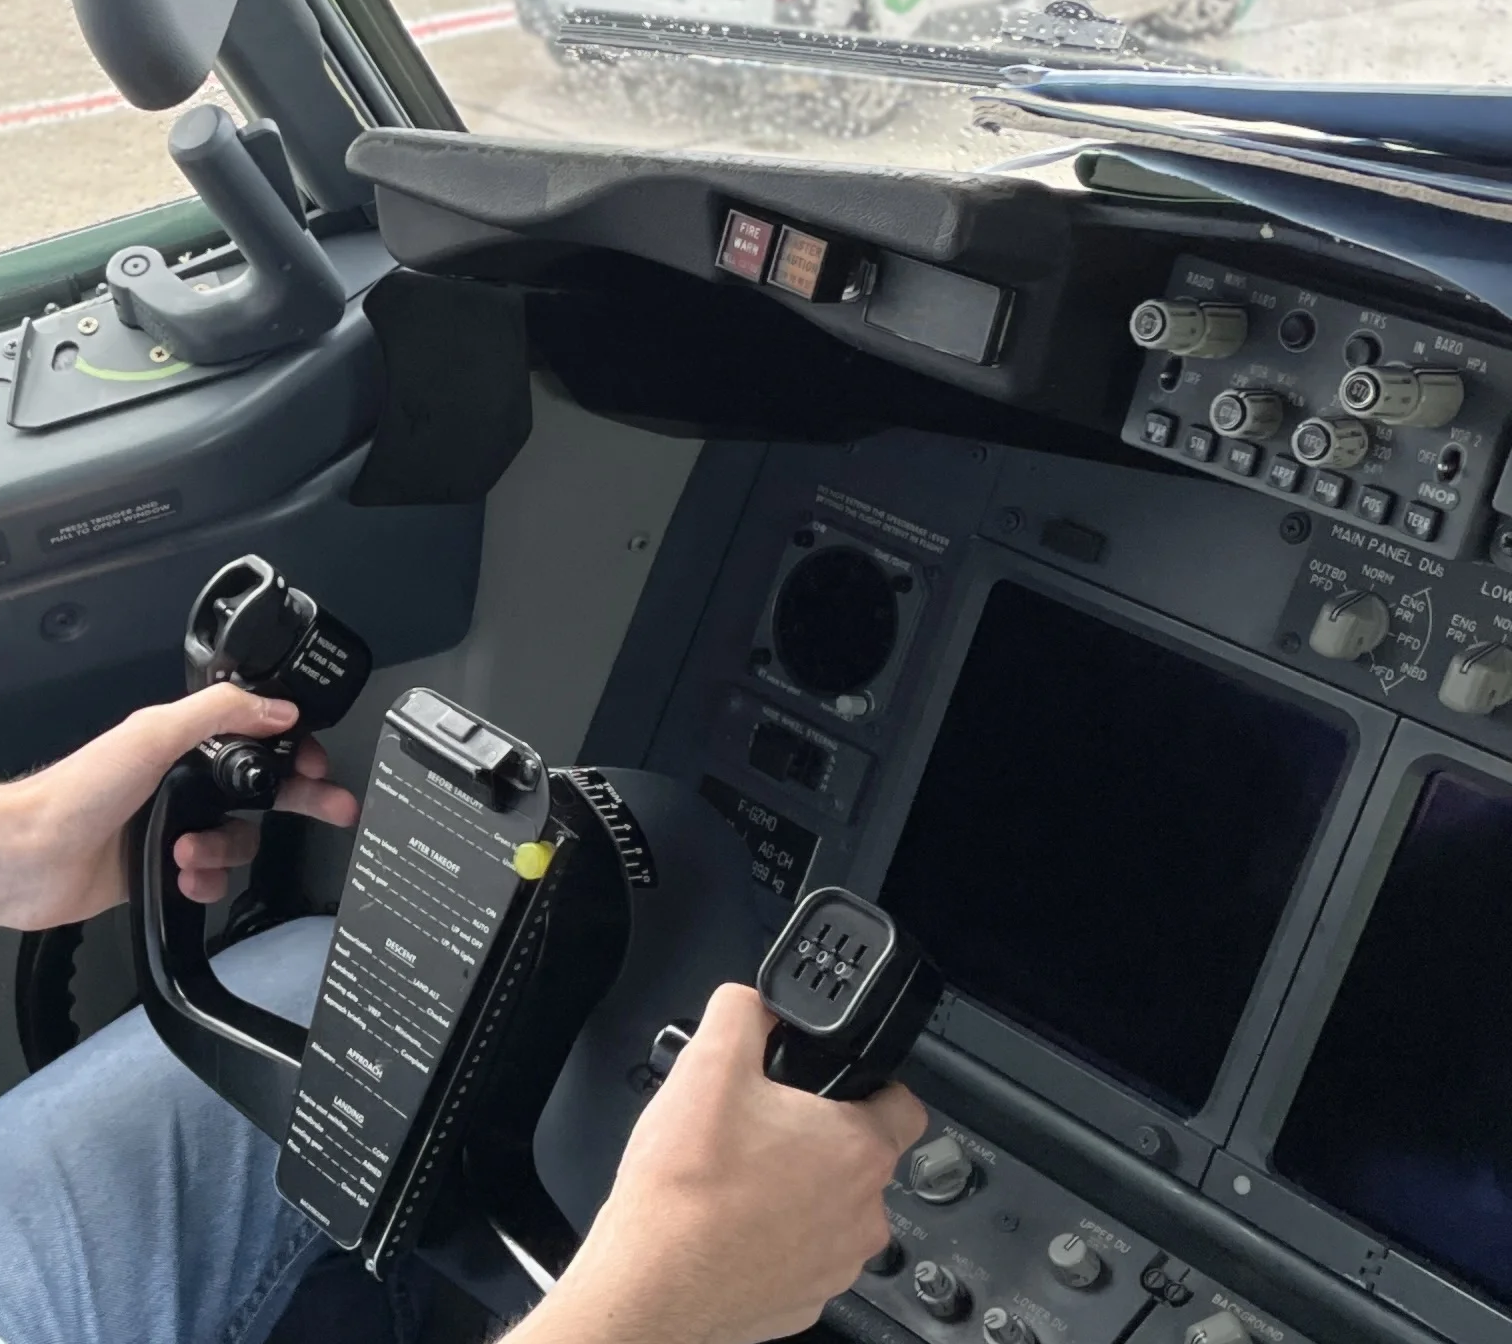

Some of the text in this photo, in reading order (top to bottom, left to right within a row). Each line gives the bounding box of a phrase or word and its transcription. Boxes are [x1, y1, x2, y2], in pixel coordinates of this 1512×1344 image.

[739, 222, 762, 240] FIRE
[733, 237, 759, 257] WARN
[1298, 291, 1318, 307] FPV
[1360, 312, 1388, 329] MTRS
[1413, 341, 1426, 355] IN
[1434, 335, 1464, 355] BARO
[1466, 357, 1487, 373] HPA
[1473, 435, 1481, 447] 2
[1374, 446, 1392, 460] 320
[1418, 449, 1438, 464] OFF
[1271, 465, 1295, 481] ARPT
[1316, 479, 1337, 497] DATA
[1418, 481, 1456, 504] INOP
[1362, 495, 1382, 513] POS
[50, 532, 73, 545] PULL
[75, 528, 91, 537] TO
[92, 519, 121, 532] OPEN
[123, 503, 171, 523] WINDOW
[59, 520, 88, 535] PRESS
[90, 508, 135, 527] TRIGGER
[135, 500, 159, 513] AND
[1407, 511, 1432, 531] TERR
[1330, 523, 1445, 578] MAIN PANEL DUs
[1309, 559, 1348, 582] OUTBD
[1361, 564, 1395, 586] NORM
[1310, 574, 1334, 592] PFD
[1399, 594, 1426, 613] ENG
[1395, 608, 1415, 624] PRI
[1451, 614, 1477, 633] ENG
[317, 636, 336, 654] NOSE
[1396, 632, 1421, 651] PFD
[1446, 627, 1467, 644] PRI
[308, 650, 345, 677] STAB TRIM
[1369, 663, 1395, 681] MFD
[1399, 662, 1428, 682] INBD
[299, 663, 330, 686] NOSE UP
[427, 770, 484, 810] BEFORE TAKEOFF
[603, 781, 622, 803] TRIM
[409, 837, 461, 874] AFTER TAKEOFF
[758, 840, 794, 870] AG-CH
[772, 872, 785, 895] kg
[486, 907, 496, 918] ON
[472, 919, 489, 933] AUTO
[451, 924, 460, 934] UP
[471, 937, 484, 949] OFF
[385, 937, 417, 963] DESCENT
[798, 940, 846, 975] 0 0 0
[412, 978, 440, 1000] LAND ALT
[346, 1047, 383, 1078] APPROACH
[400, 1049, 430, 1073] Completed
[333, 1095, 365, 1123] LANDING
[372, 1147, 389, 1163] CONT
[965, 1139, 997, 1166] PANEL
[1079, 1218, 1132, 1254] UPPER DU
[1012, 1292, 1068, 1332] LOWER DU
[1210, 1292, 1285, 1343] BACKGROUND
